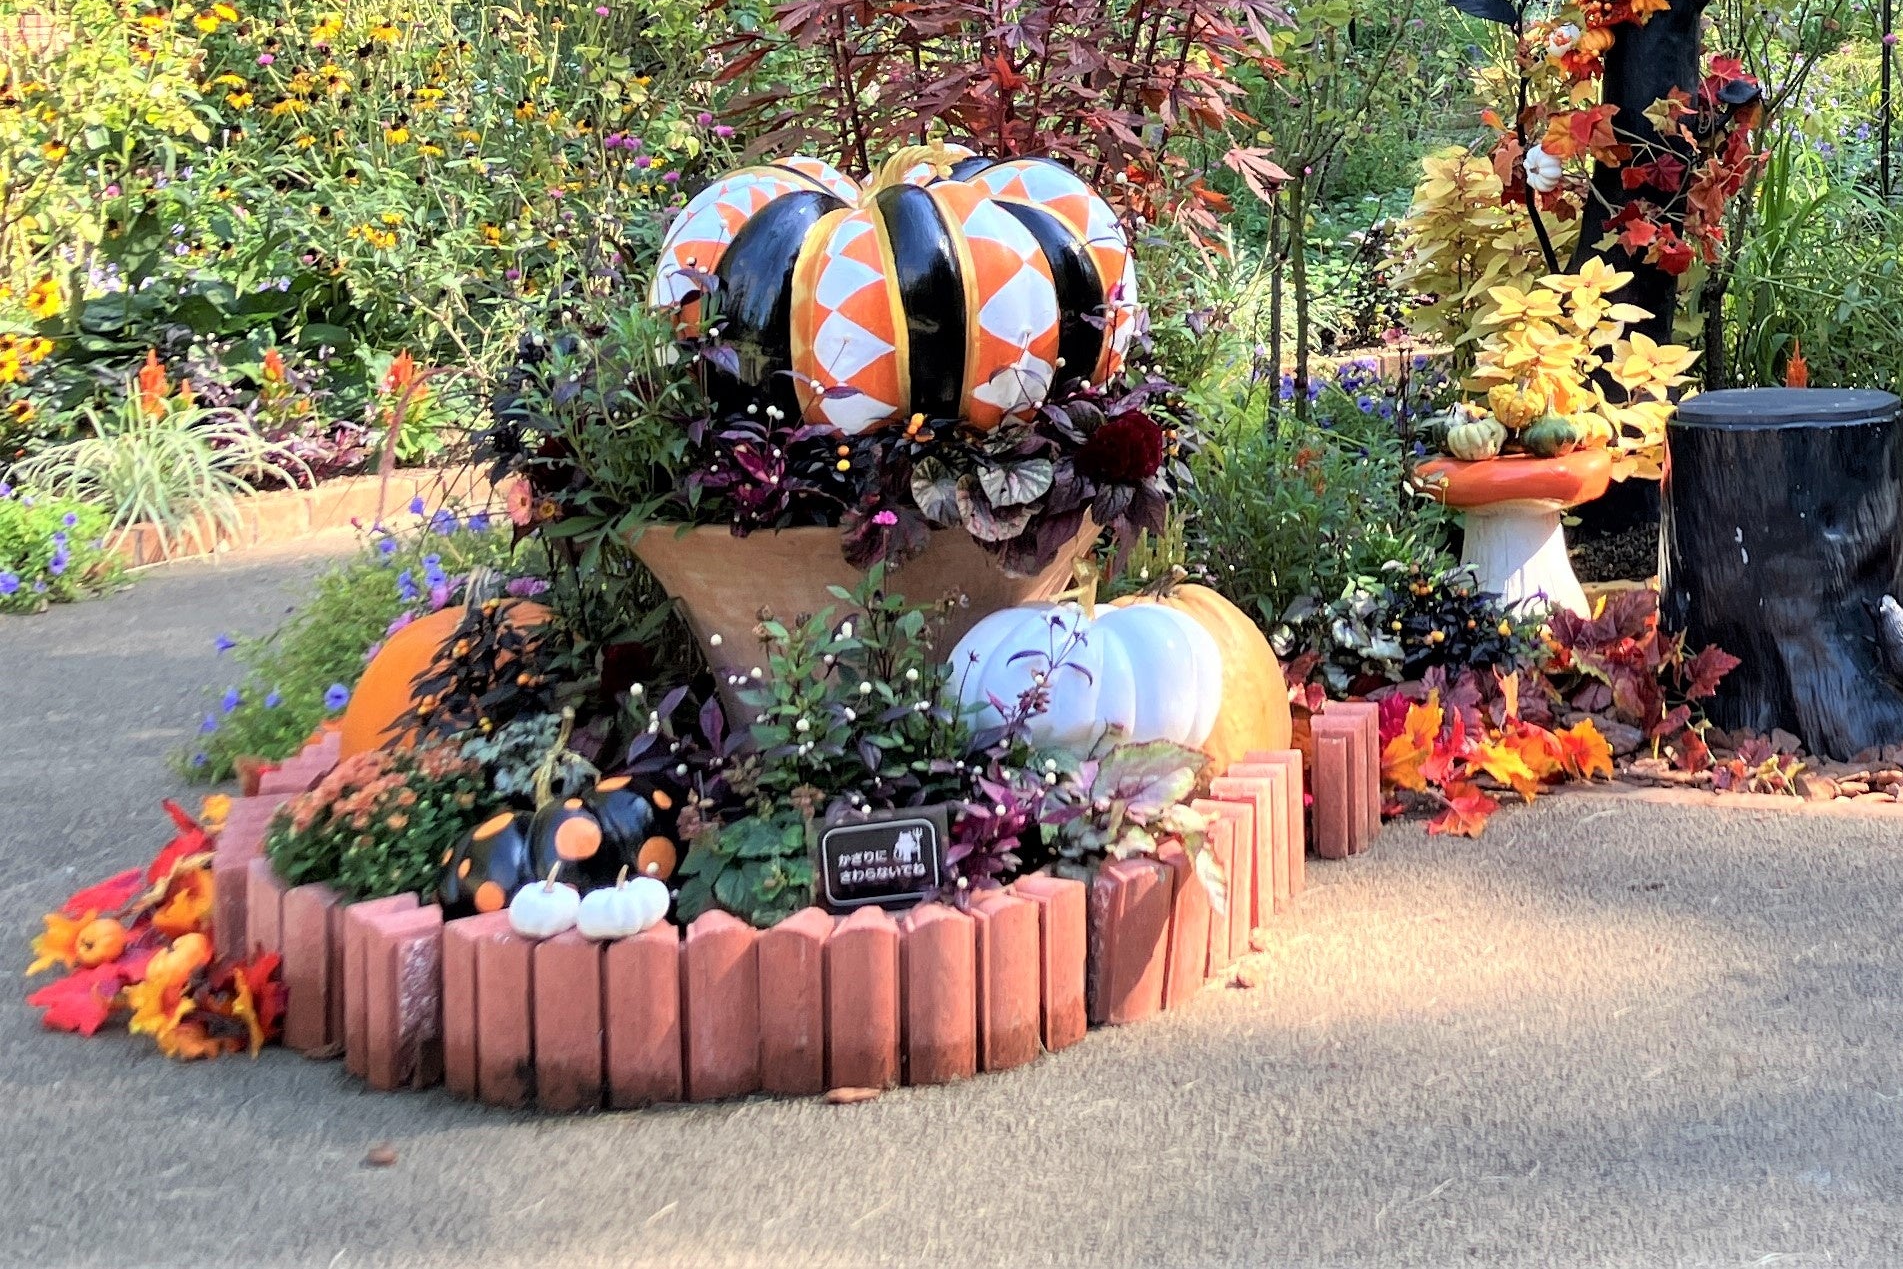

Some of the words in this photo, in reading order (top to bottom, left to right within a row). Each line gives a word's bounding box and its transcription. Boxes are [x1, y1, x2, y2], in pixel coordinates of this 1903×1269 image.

[838, 849, 887, 867] かざりに
[840, 863, 926, 885] さわらないでね
